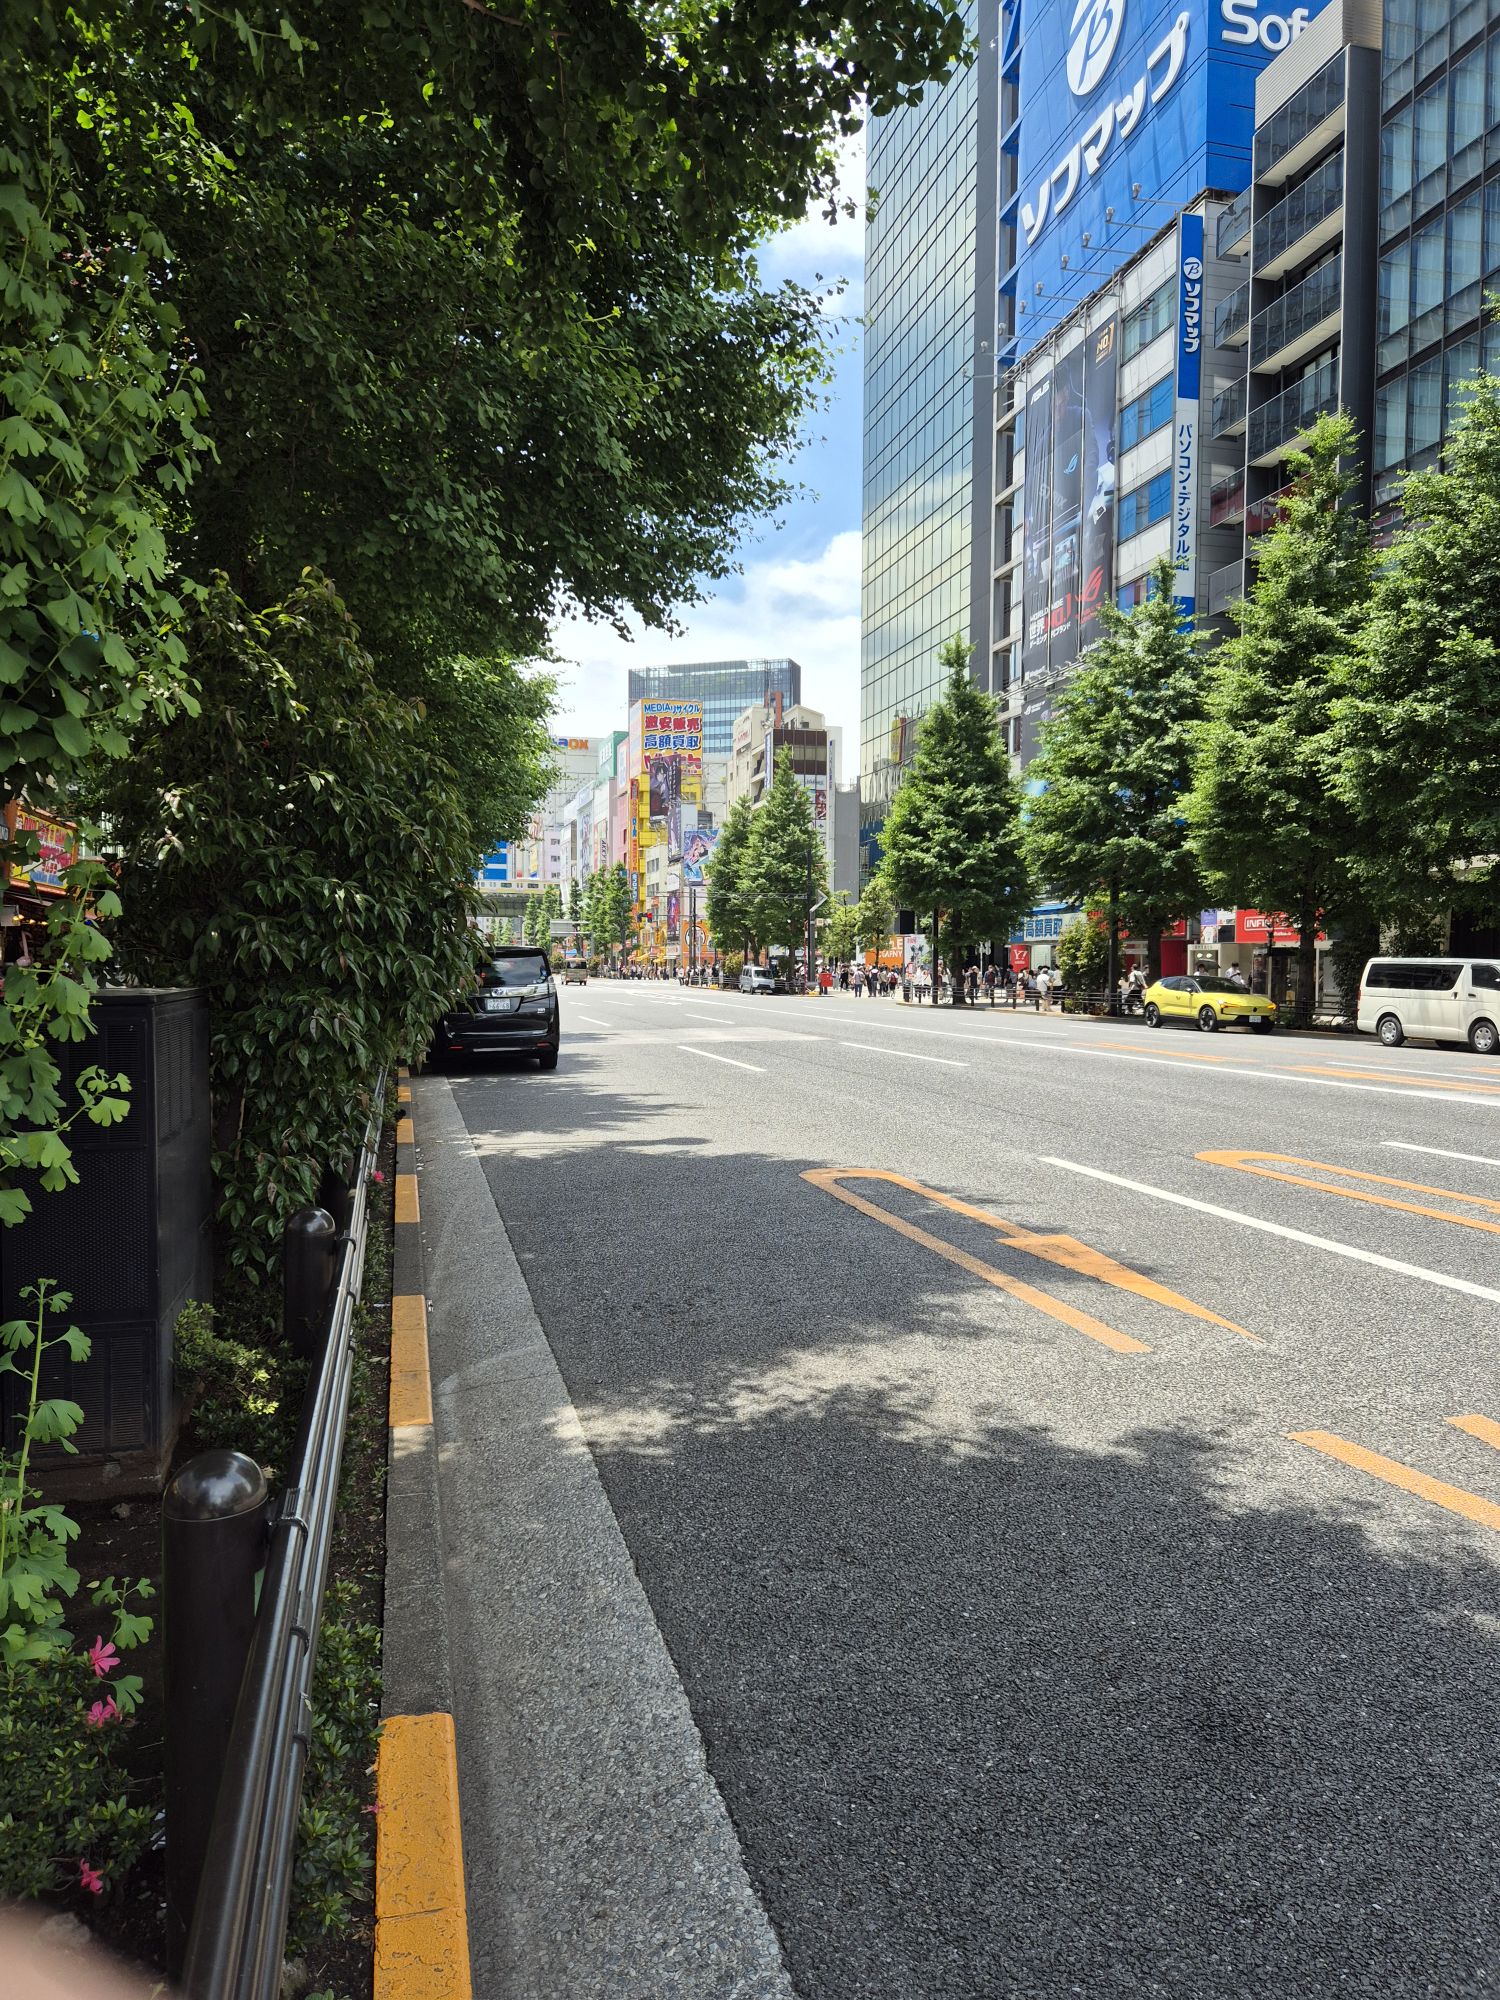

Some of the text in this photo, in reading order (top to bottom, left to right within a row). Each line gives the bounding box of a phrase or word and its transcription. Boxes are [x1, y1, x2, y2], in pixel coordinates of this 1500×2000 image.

[1021, 11, 1190, 246] ソフマップ
[1184, 282, 1201, 353] ソフマップ
[1030, 380, 1050, 405] ASUS
[644, 734, 699, 749] 高額買取
